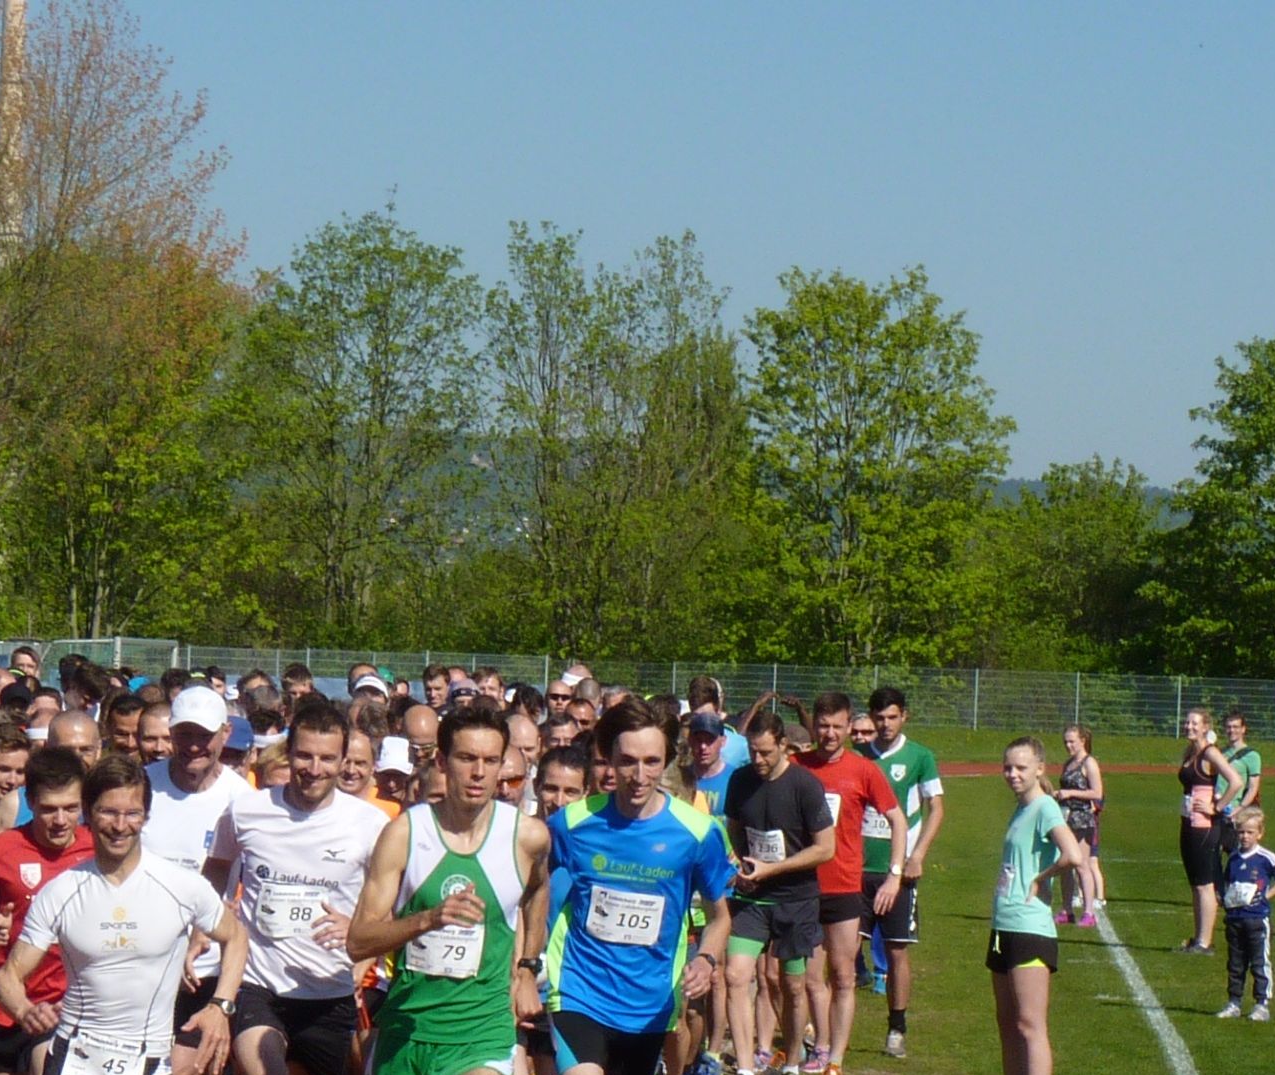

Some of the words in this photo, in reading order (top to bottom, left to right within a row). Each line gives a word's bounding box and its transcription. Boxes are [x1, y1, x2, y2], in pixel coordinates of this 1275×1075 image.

[289, 906, 313, 922] 88
[615, 912, 652, 930] 105
[441, 944, 467, 961] 79
[102, 1057, 128, 1075] 45
